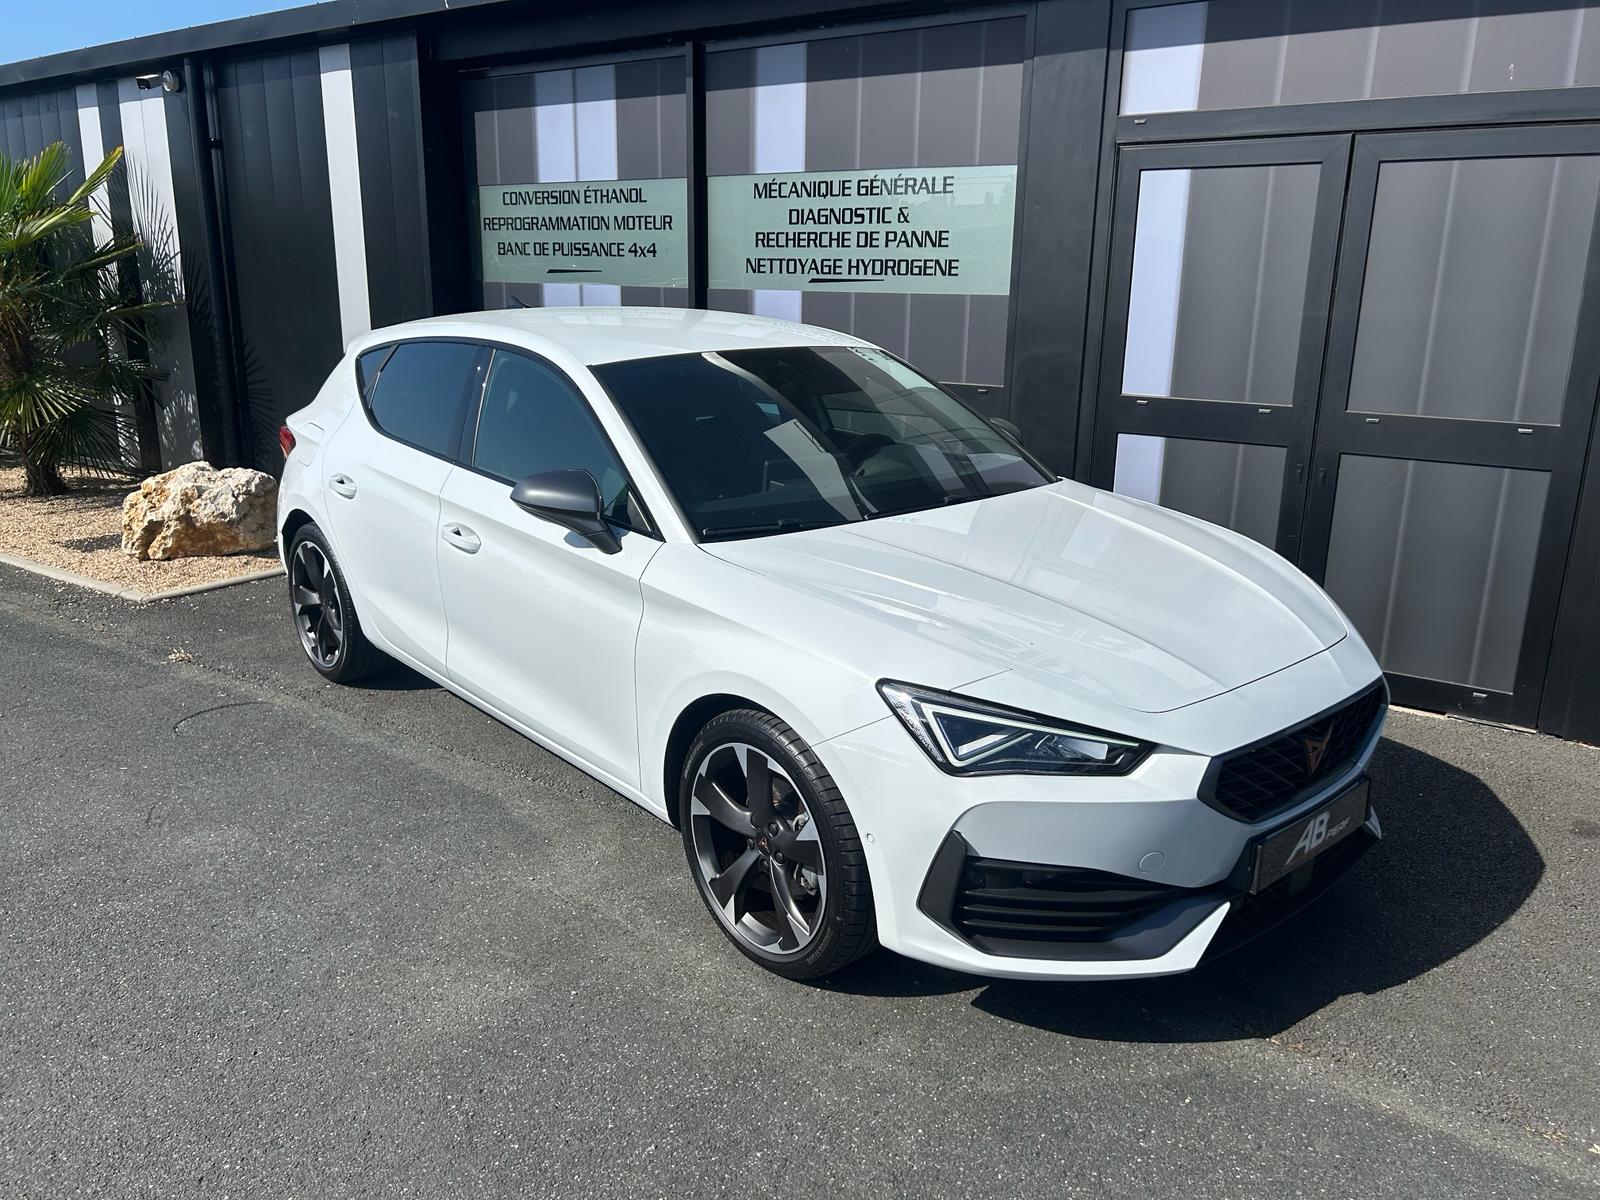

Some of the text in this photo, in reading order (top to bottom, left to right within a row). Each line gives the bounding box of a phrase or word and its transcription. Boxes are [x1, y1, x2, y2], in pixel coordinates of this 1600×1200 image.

[502, 186, 647, 206] CONVERSION ÉTHANOL
[753, 174, 954, 199] MÉCANIQUE GÉNÉRALE
[483, 215, 673, 231] REPROGRAMMATION MOTEUR
[788, 207, 910, 225] DIAGNOSTIC &
[755, 230, 949, 248] RECHERCHE DE PANNE
[498, 242, 657, 258] BANC DE PUISSANCE 4x4
[745, 257, 959, 277] NETTOYAGE HYDROGENE
[1284, 811, 1330, 866] AB
